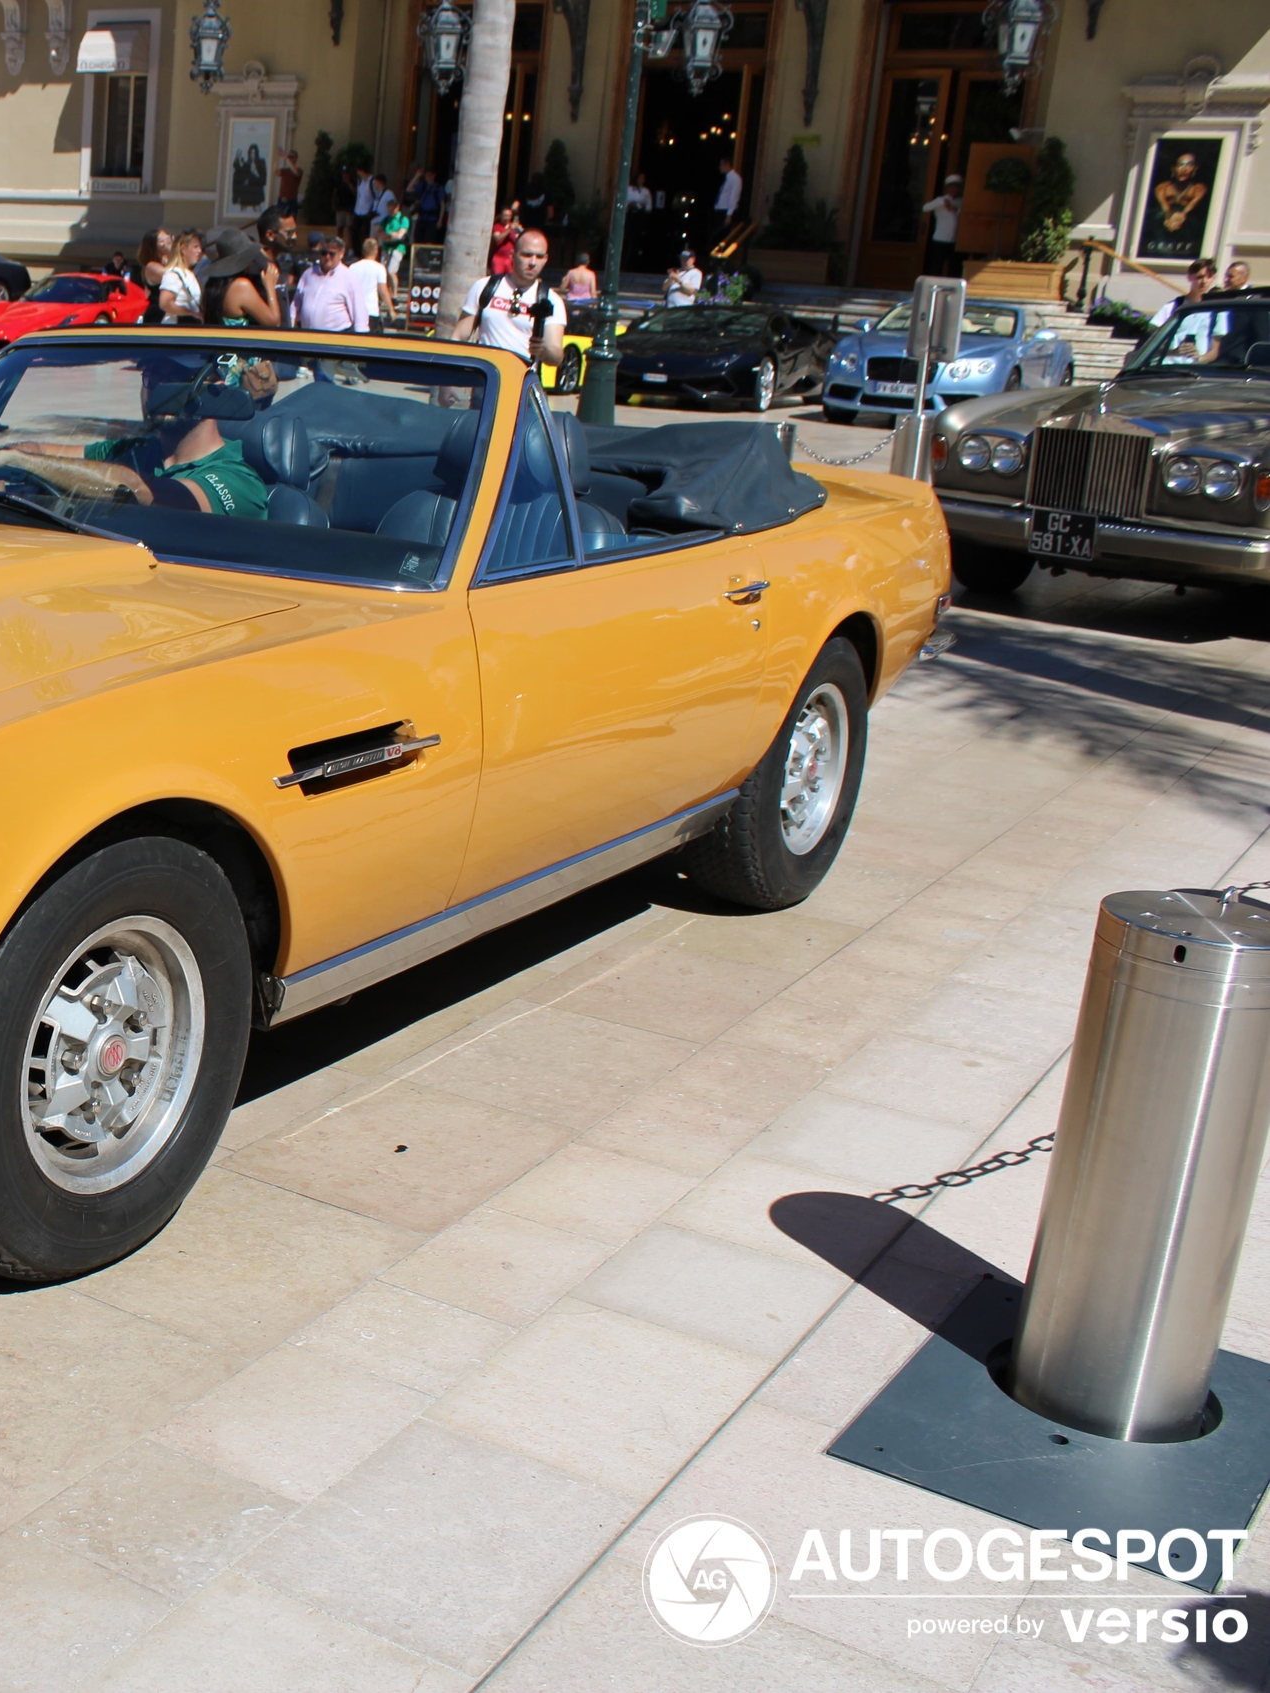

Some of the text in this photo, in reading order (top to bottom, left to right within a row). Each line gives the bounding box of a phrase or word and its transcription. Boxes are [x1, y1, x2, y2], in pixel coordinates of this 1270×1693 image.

[205, 473, 235, 511] CLASSIC
[353, 750, 383, 765] MARTIN
[387, 745, 401, 757] V8
